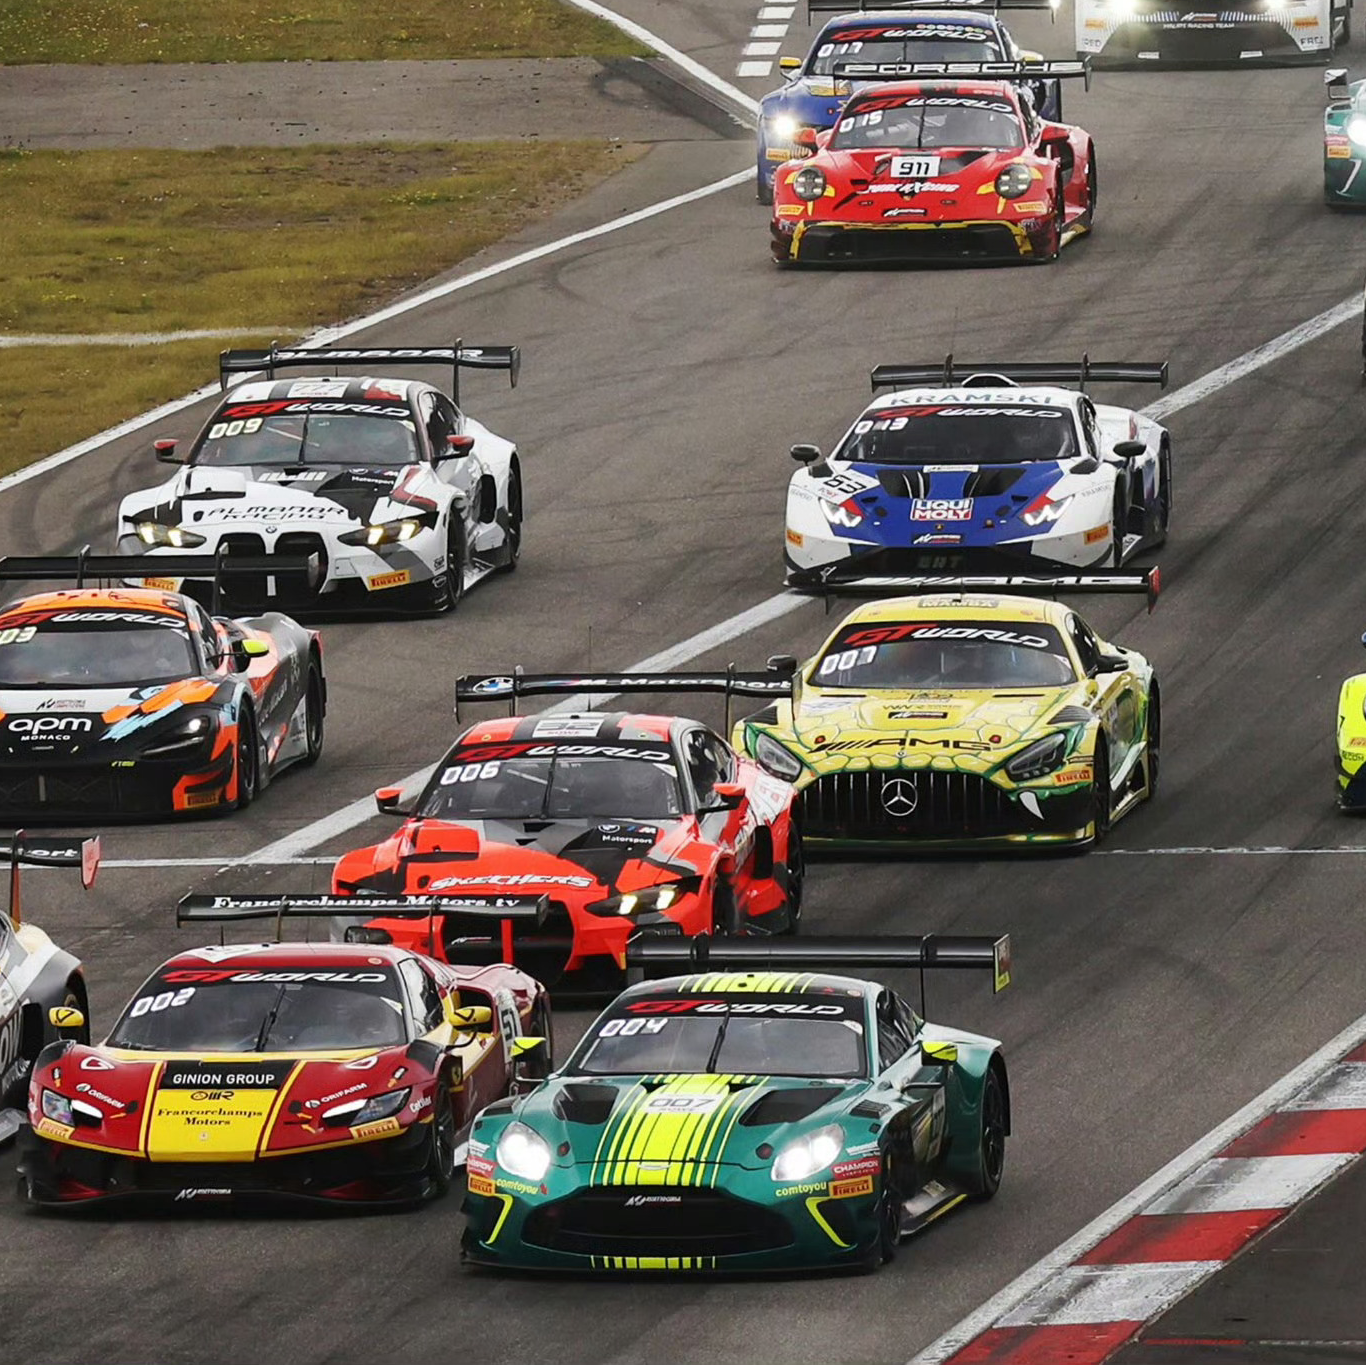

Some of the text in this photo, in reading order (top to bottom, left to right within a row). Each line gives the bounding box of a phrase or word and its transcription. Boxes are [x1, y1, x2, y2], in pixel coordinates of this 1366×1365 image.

[844, 62, 1084, 74] PORSCHE
[905, 98, 1013, 111] WORLD
[900, 162, 931, 175] 911
[890, 394, 1053, 405] KRAMSKI
[283, 402, 412, 418] WORLD
[937, 407, 1064, 418] WORLD
[207, 417, 265, 441] 009
[206, 505, 347, 515] ALMANAR
[915, 498, 972, 510] LIQUI
[912, 509, 971, 521] MOLY
[369, 573, 406, 589] PIRELLI
[49, 612, 187, 628] WORLD
[911, 627, 1050, 649] WORLD
[7, 715, 93, 734] apm
[526, 745, 671, 761] WORLD
[439, 761, 501, 785] 006
[601, 834, 654, 845] Motorsport
[427, 873, 596, 890] SKECHERS
[211, 894, 400, 909] Francorchamps
[230, 971, 387, 984] WORLD
[129, 987, 197, 1018] 002
[696, 1003, 846, 1016] WORLD
[598, 1017, 669, 1038] 004
[172, 1073, 276, 1085] GINION GROUP
[87, 1089, 127, 1109] ORIFARM
[320, 1082, 368, 1104] ORIFARM
[648, 1098, 716, 1108] 007
[156, 1108, 263, 1119] Francorchamps
[183, 1117, 231, 1126] Motors
[355, 1121, 397, 1138] PIRELLI
[833, 1160, 879, 1174] CHAMPION
[495, 1177, 539, 1194] comtoyou
[775, 1181, 827, 1198] comtoyou
[832, 1178, 871, 1196] PIRELLI
